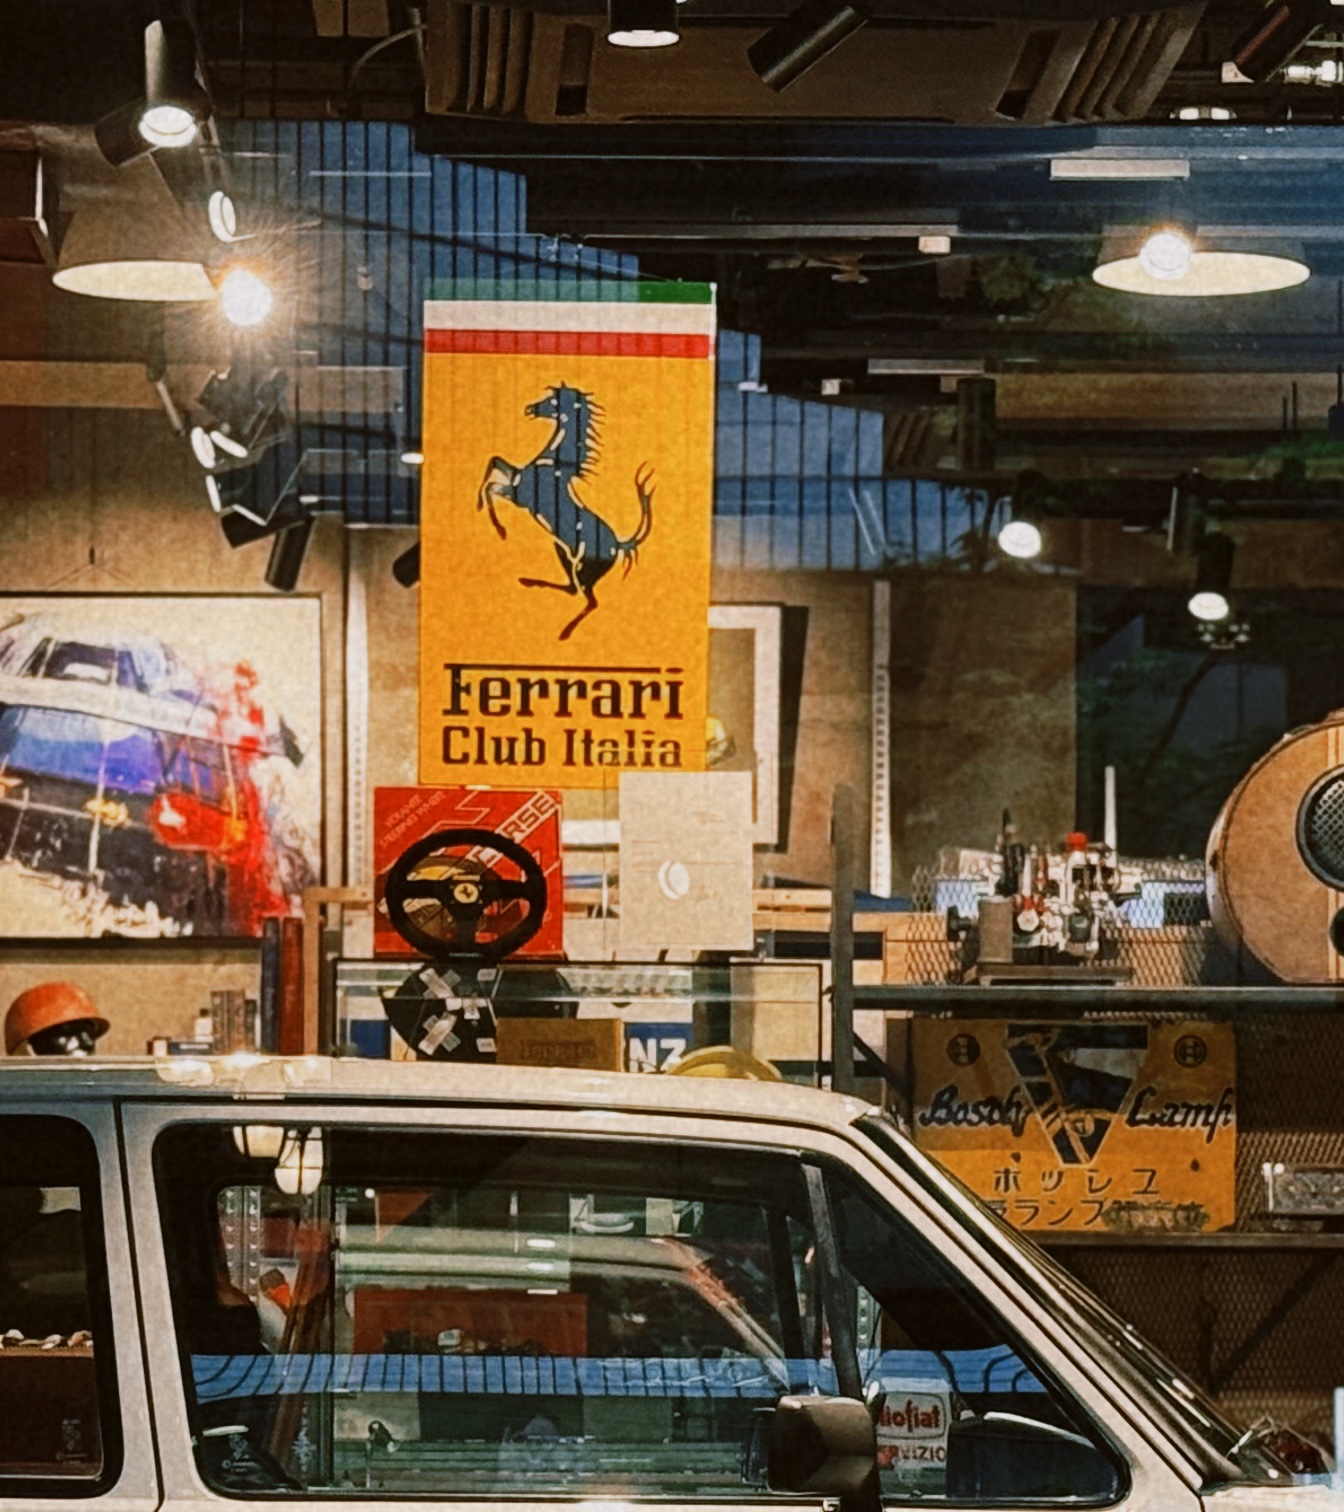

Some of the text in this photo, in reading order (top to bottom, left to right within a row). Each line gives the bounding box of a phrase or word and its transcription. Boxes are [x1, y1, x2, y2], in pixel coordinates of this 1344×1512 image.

[442, 663, 684, 719] Ferrari
[442, 725, 682, 768] Club Italia
[919, 1084, 1233, 1144] Bosch Lamp
